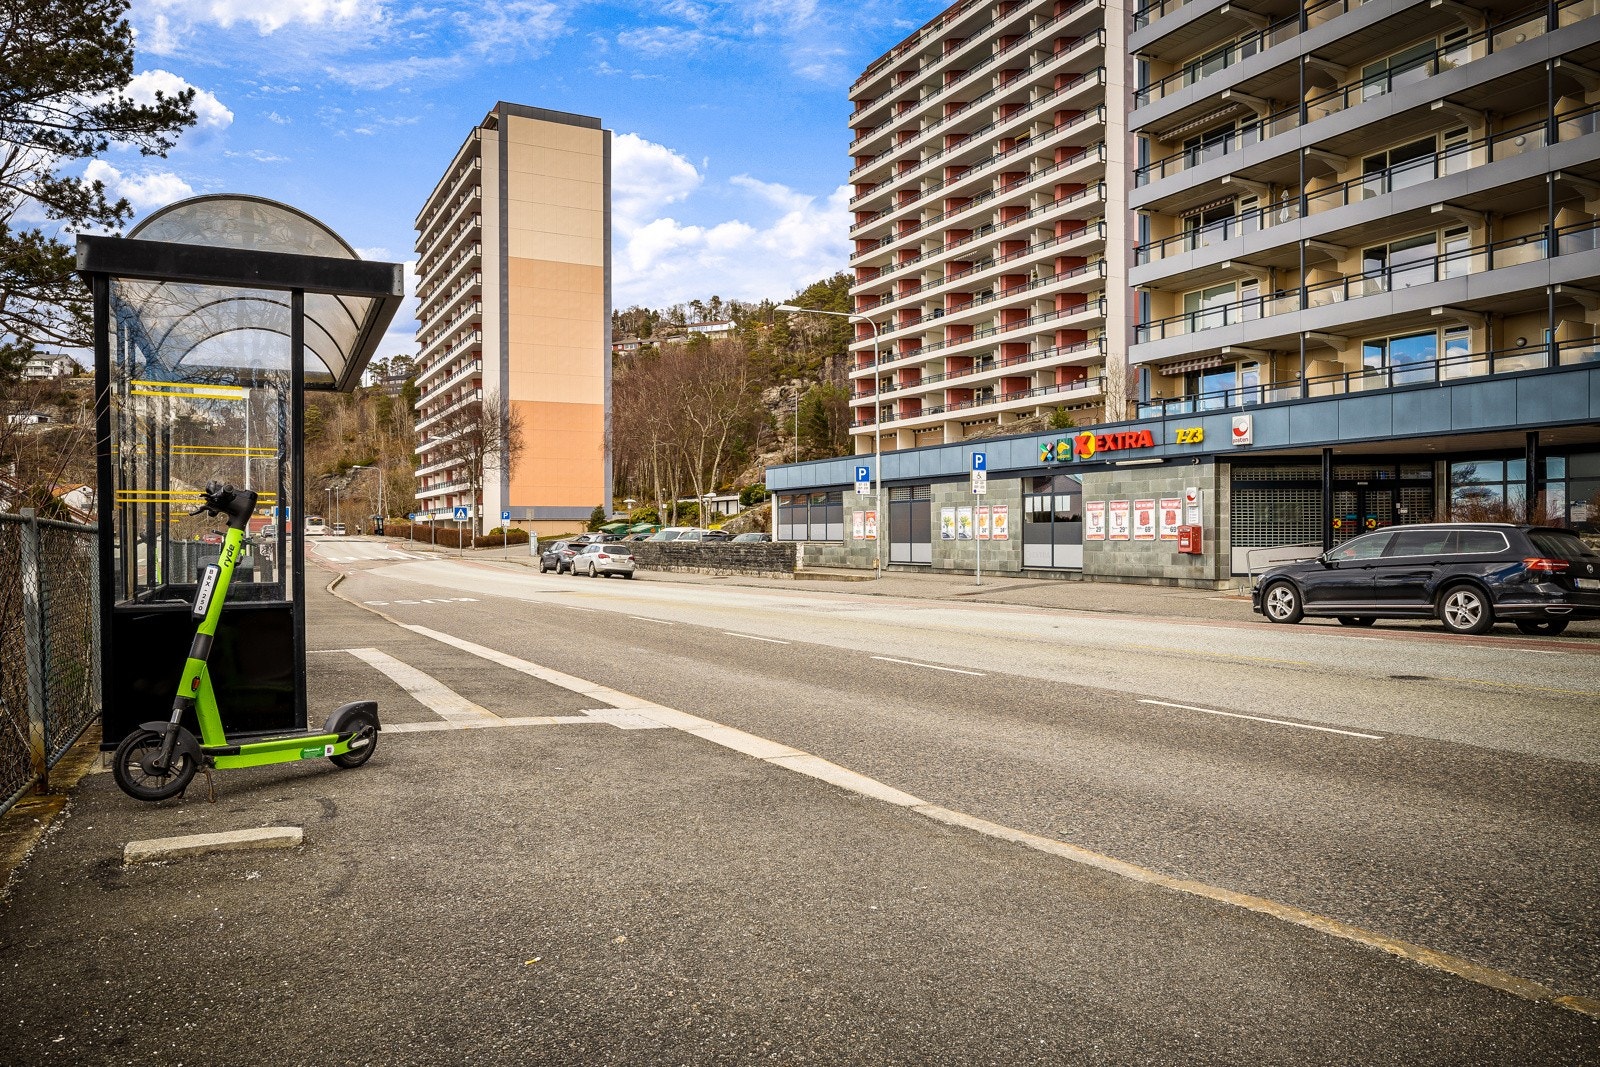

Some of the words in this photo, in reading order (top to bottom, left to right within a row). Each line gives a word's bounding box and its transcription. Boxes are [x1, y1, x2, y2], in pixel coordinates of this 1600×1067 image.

[1095, 429, 1154, 452] EXTRA
[1175, 427, 1204, 444] 7-23
[975, 454, 983, 468] P
[858, 468, 867, 480] P
[224, 544, 235, 567] ryde
[198, 569, 214, 611] BRX-250
